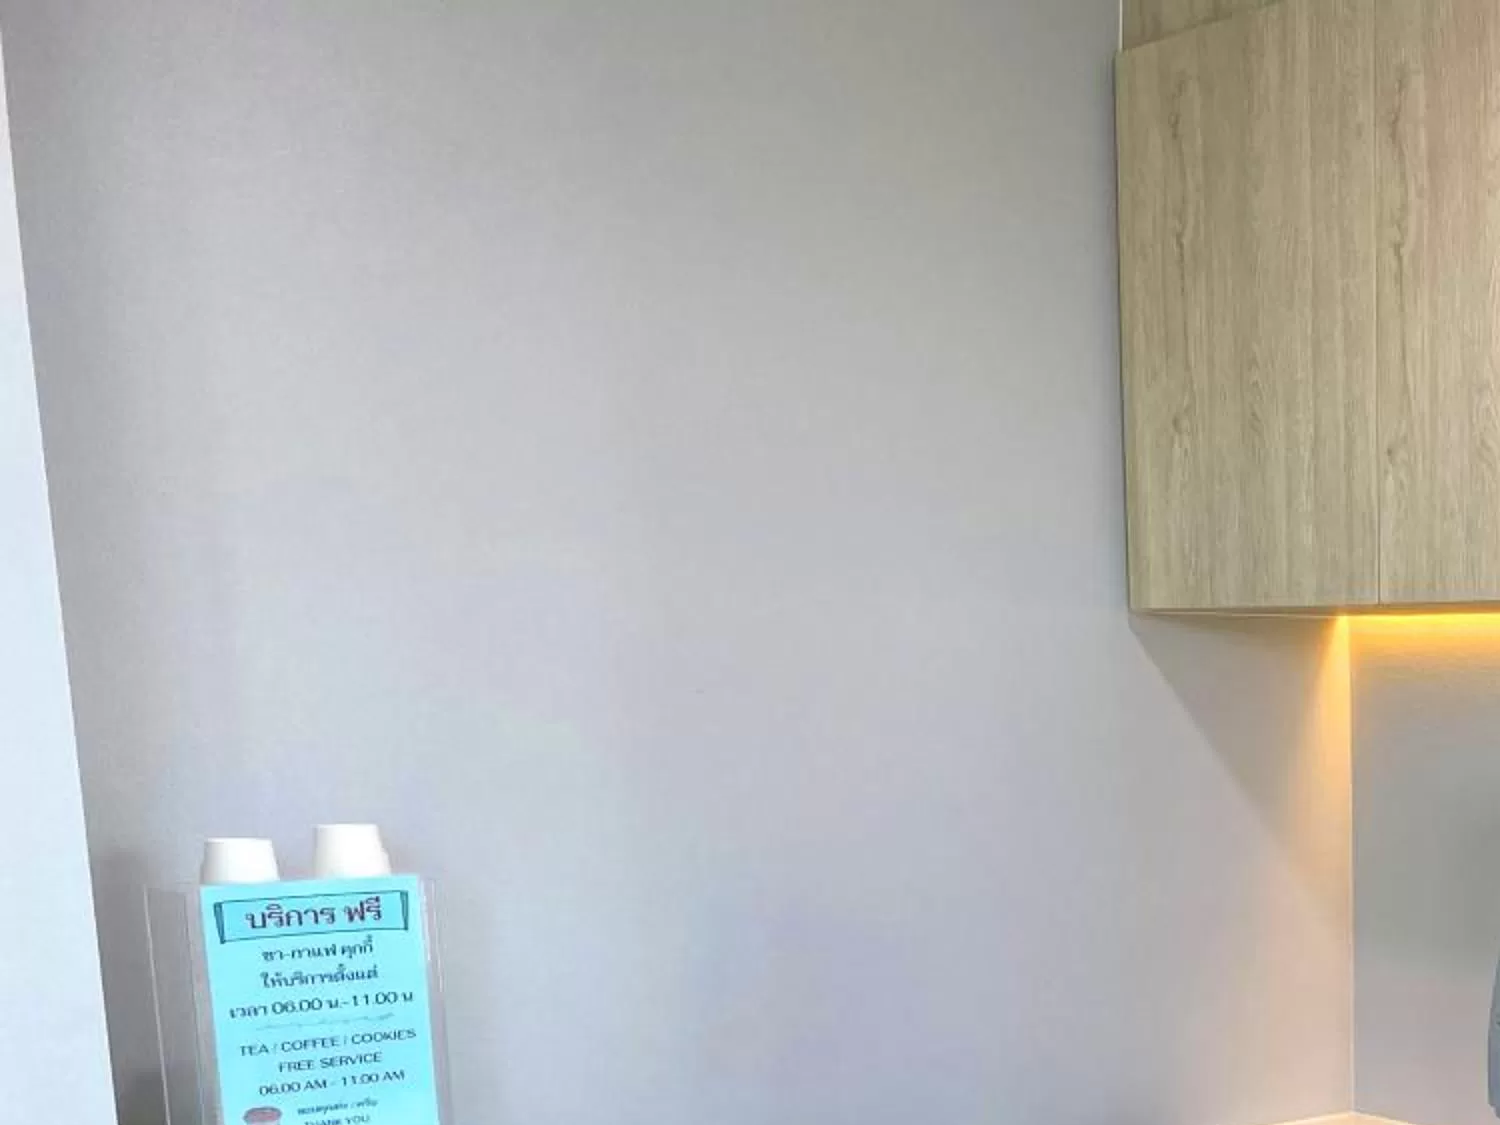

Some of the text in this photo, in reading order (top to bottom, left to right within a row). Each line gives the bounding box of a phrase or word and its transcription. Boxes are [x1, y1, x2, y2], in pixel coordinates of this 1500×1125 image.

[245, 896, 382, 929] บริการ ฟรี
[229, 1005, 267, 1019] เวลา
[272, 998, 323, 1015] 06.00
[240, 1044, 269, 1057] TEA
[281, 1036, 340, 1051] COFFEE
[351, 1028, 417, 1045] COOKIES
[279, 1051, 383, 1072] FREE SERVICE
[259, 1081, 301, 1096] 06.00
[303, 1079, 328, 1090] AM
[341, 1073, 379, 1087] 11.00
[382, 1069, 405, 1081] AM
[347, 1115, 370, 1125] YOU
